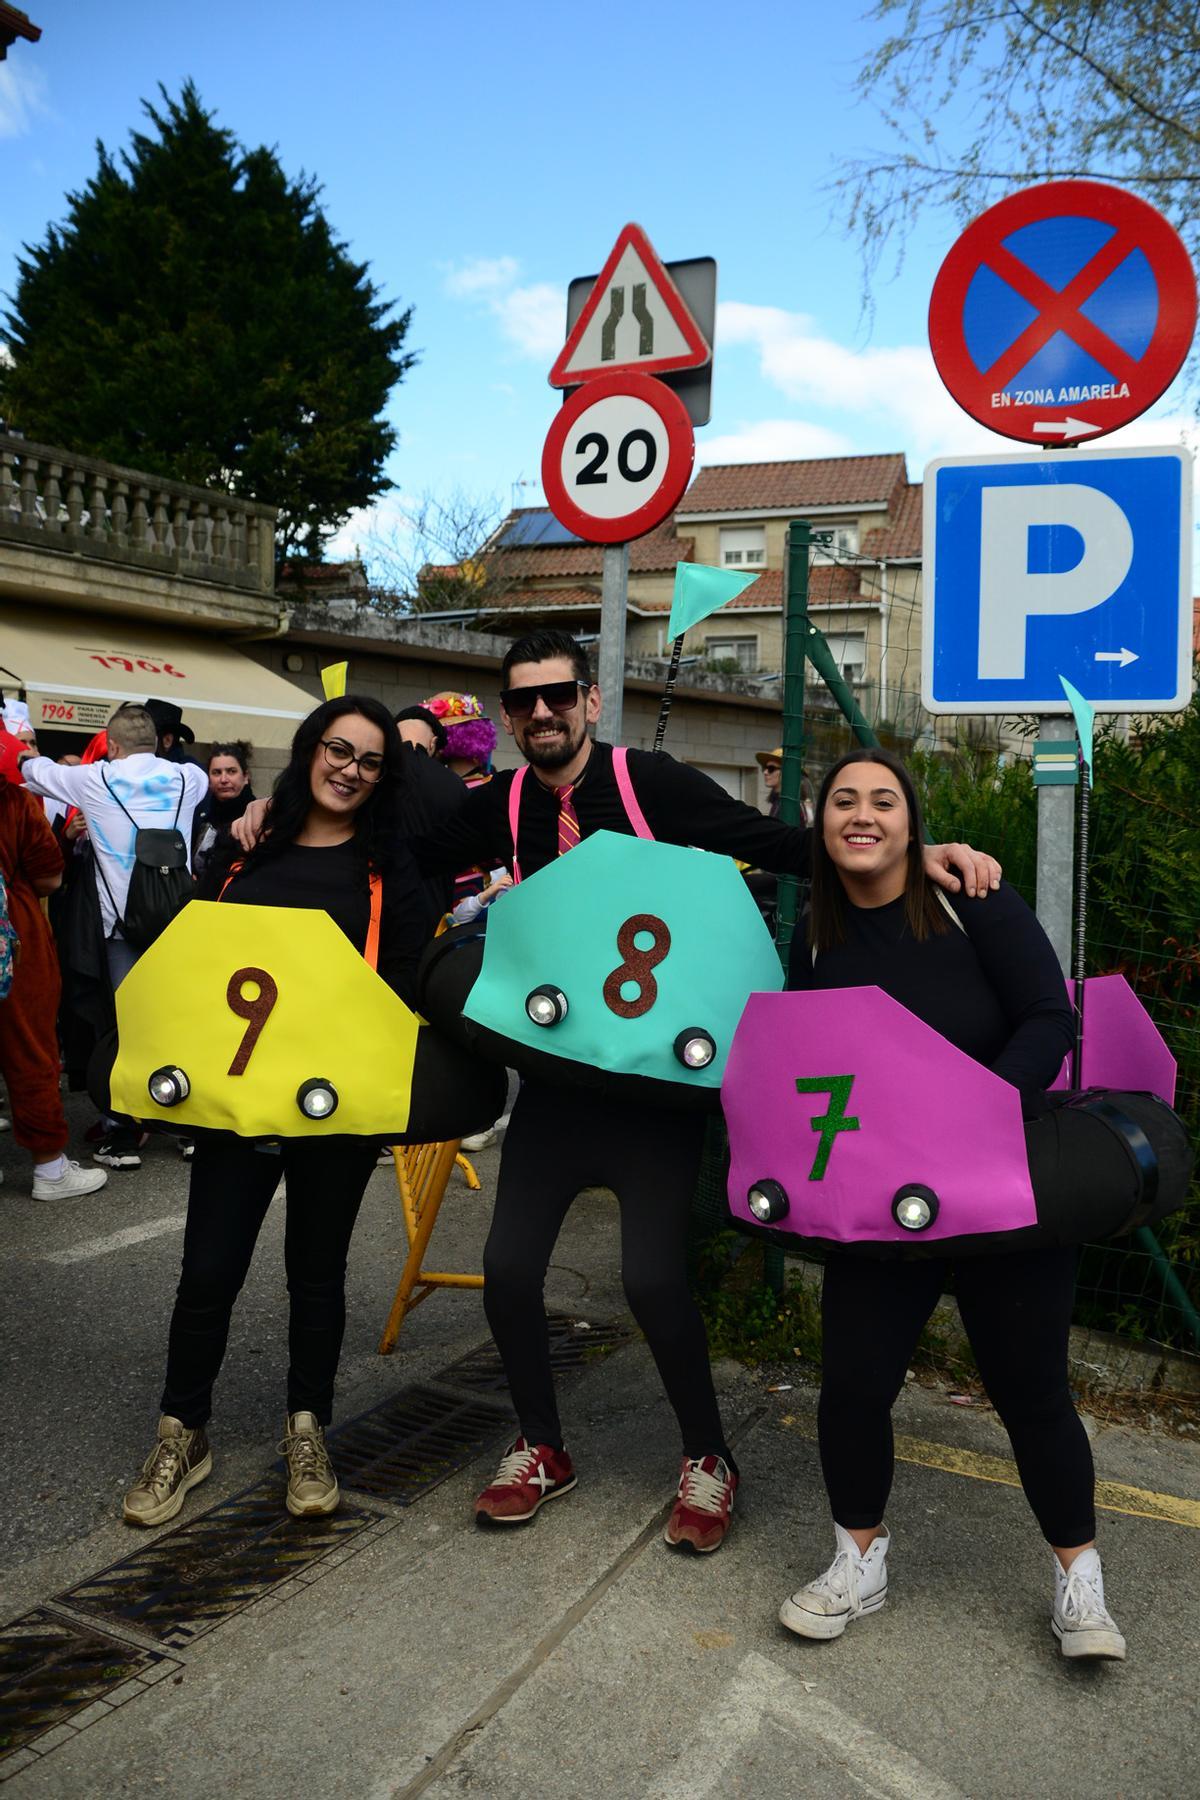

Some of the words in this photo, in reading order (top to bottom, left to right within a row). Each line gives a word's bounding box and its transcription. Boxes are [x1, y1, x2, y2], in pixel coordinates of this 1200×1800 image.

[990, 392, 1012, 408] EN
[1014, 388, 1055, 406] ZONA
[1058, 382, 1132, 403] AMARELA
[575, 428, 657, 486] 20
[977, 484, 1134, 680] P
[89, 654, 186, 678] 1906
[42, 704, 75, 721] 1906
[604, 914, 670, 1018] 8
[226, 966, 278, 1076] 9
[795, 1075, 861, 1182] 7
